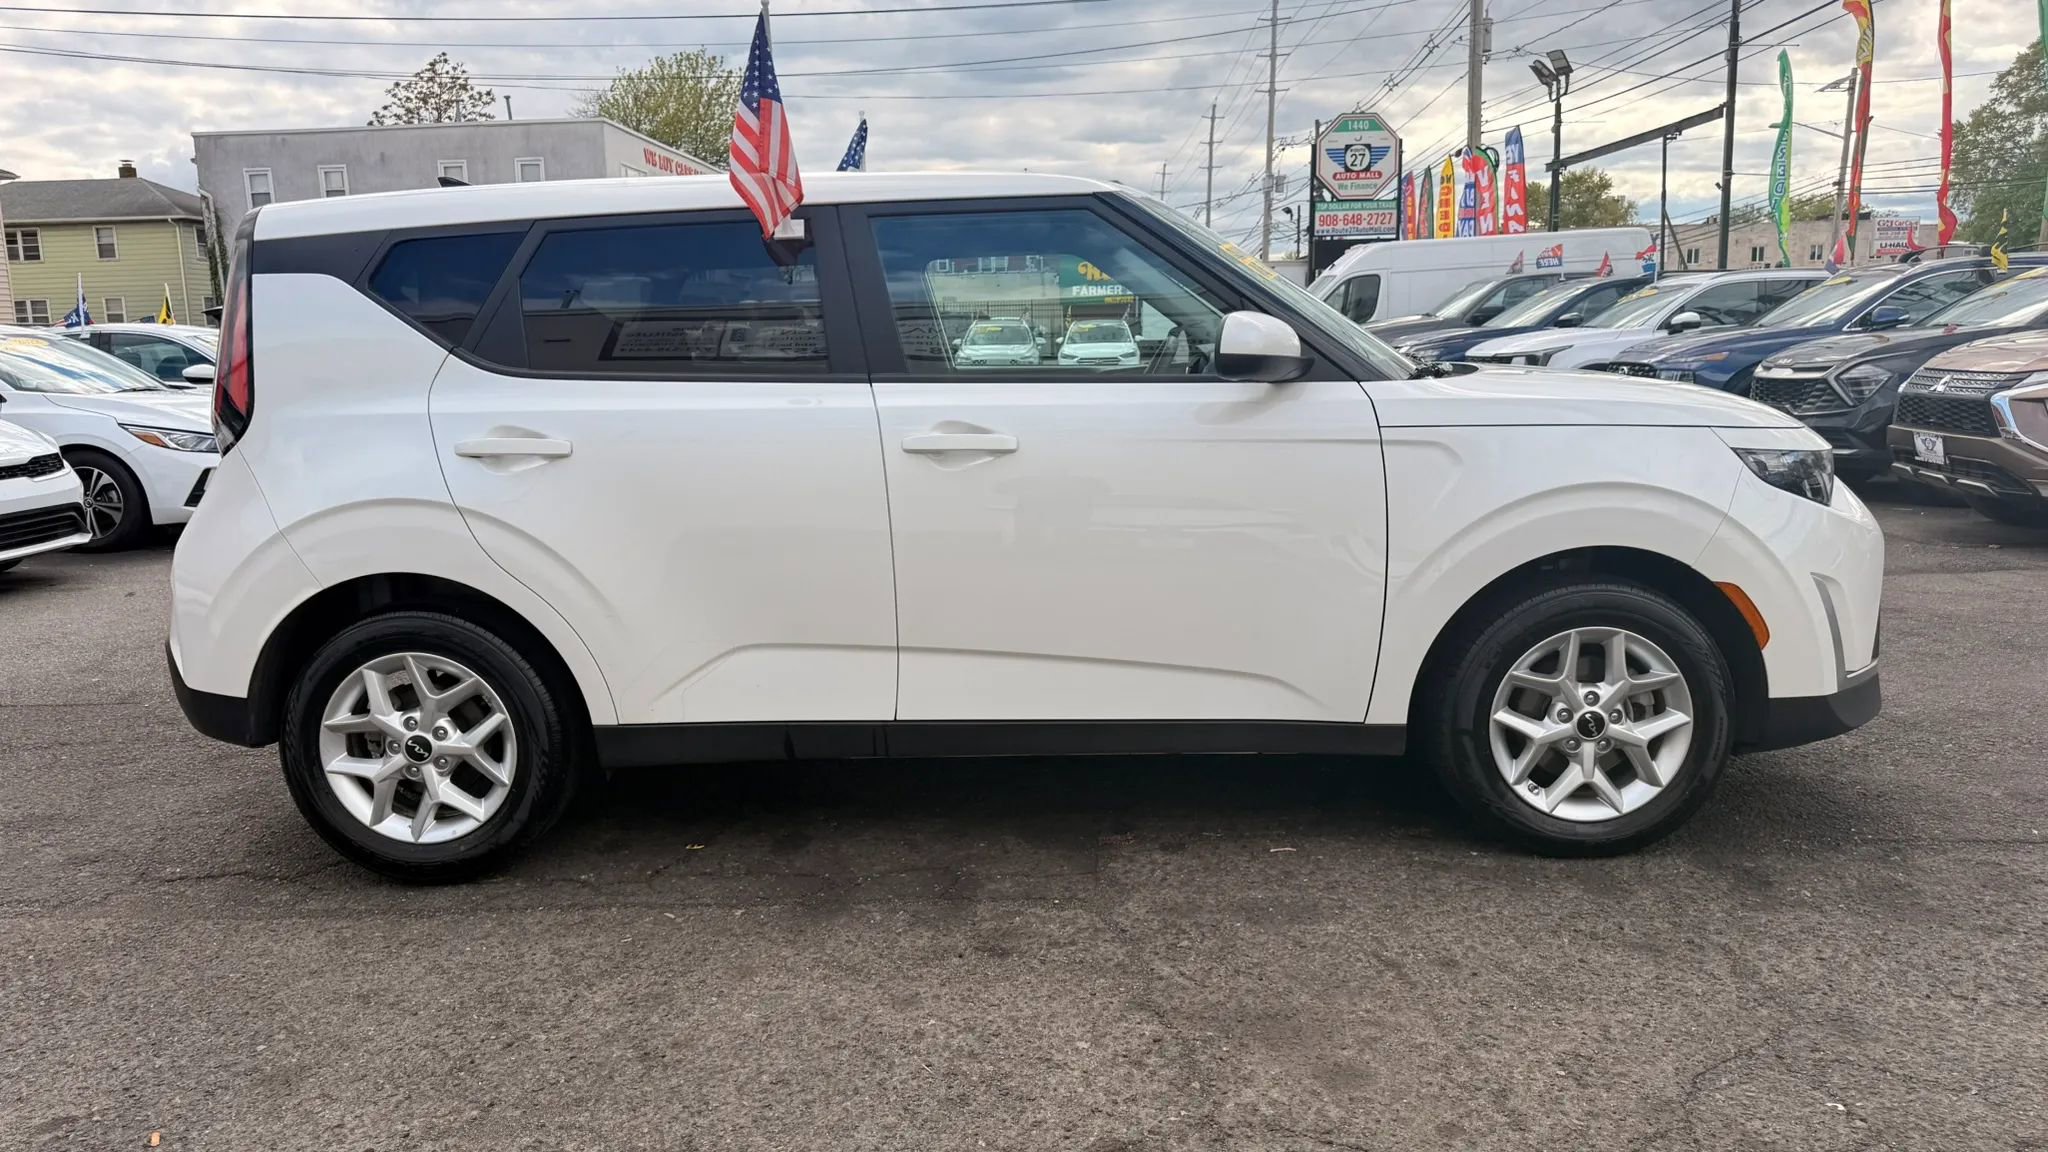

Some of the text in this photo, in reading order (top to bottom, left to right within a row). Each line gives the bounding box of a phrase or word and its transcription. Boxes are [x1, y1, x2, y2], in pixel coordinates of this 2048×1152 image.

[1348, 121, 1370, 130] 1440
[1350, 153, 1366, 167] 27
[1335, 171, 1380, 180] AUTO MALL
[1338, 181, 1378, 190] We Finance
[1318, 212, 1393, 227] 908-648-2727
